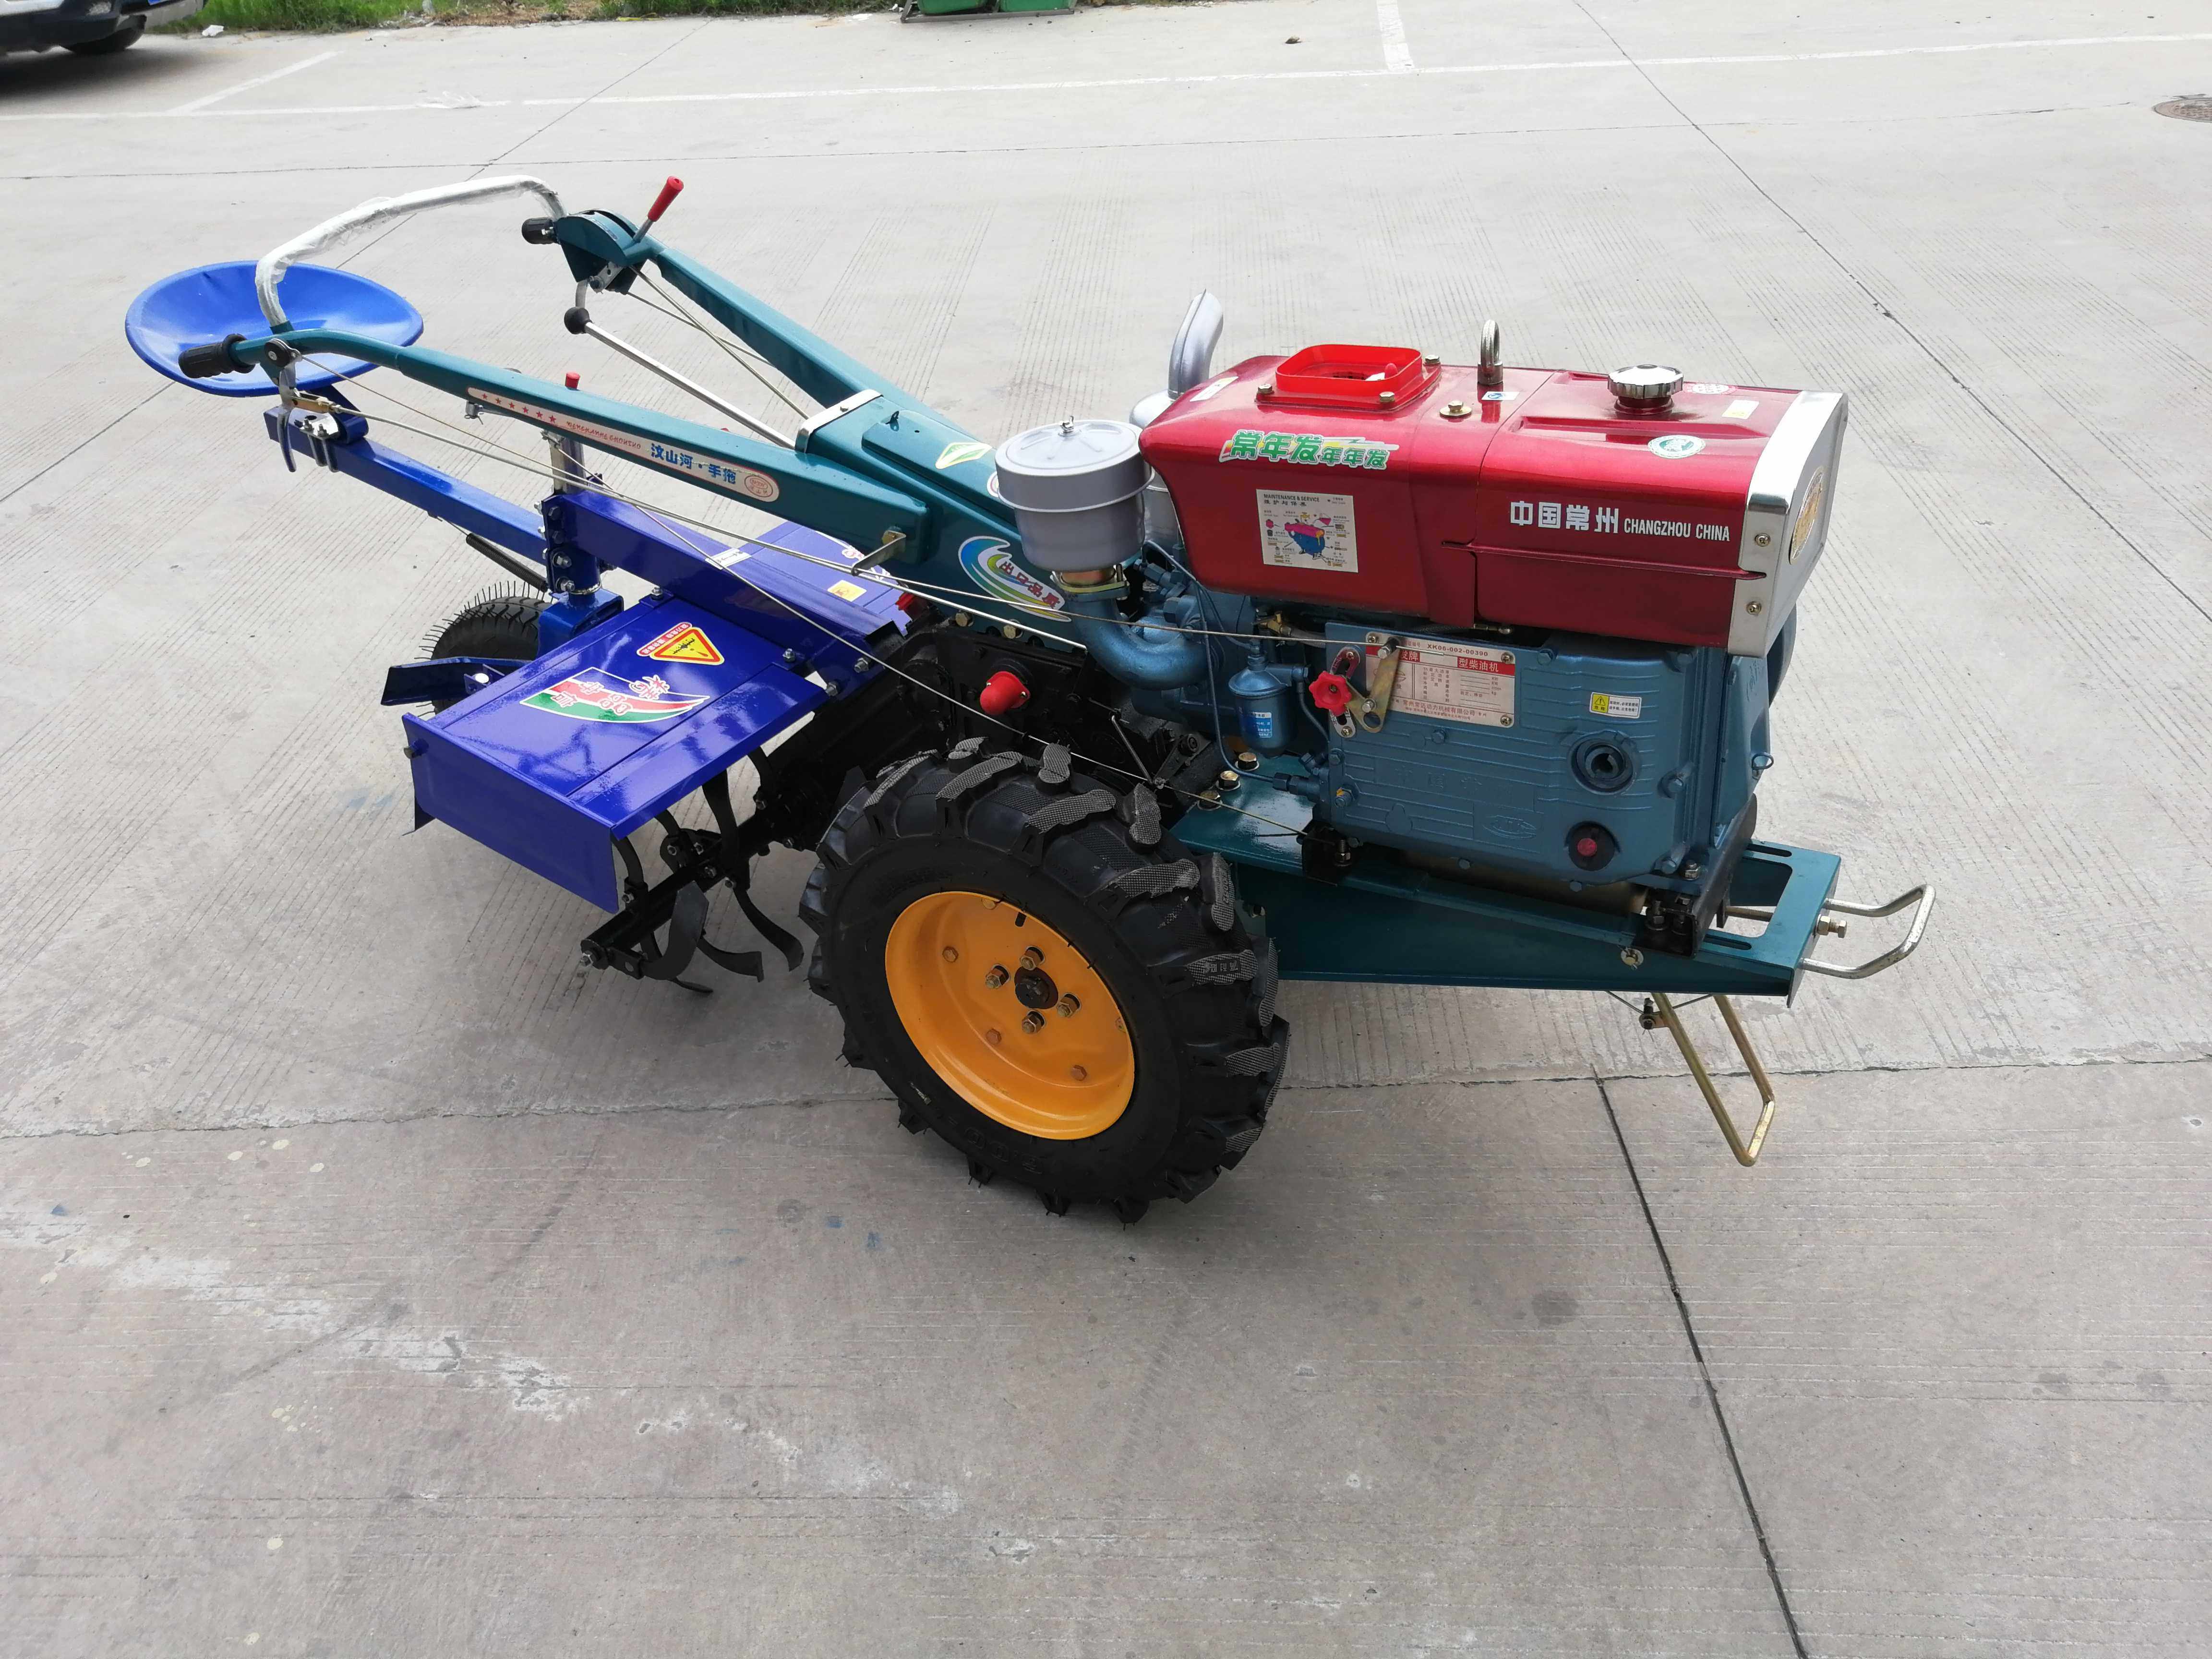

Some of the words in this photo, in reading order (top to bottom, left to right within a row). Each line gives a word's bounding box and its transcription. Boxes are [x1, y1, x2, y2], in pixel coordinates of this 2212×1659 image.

[1510, 501, 1619, 534] 中国常州
[1624, 518, 1691, 538] CHANGZHOU
[1695, 524, 1730, 542] CHINA
[1428, 644, 1489, 657] XK06-002-00390
[1459, 658, 1499, 673] 型柴油机
